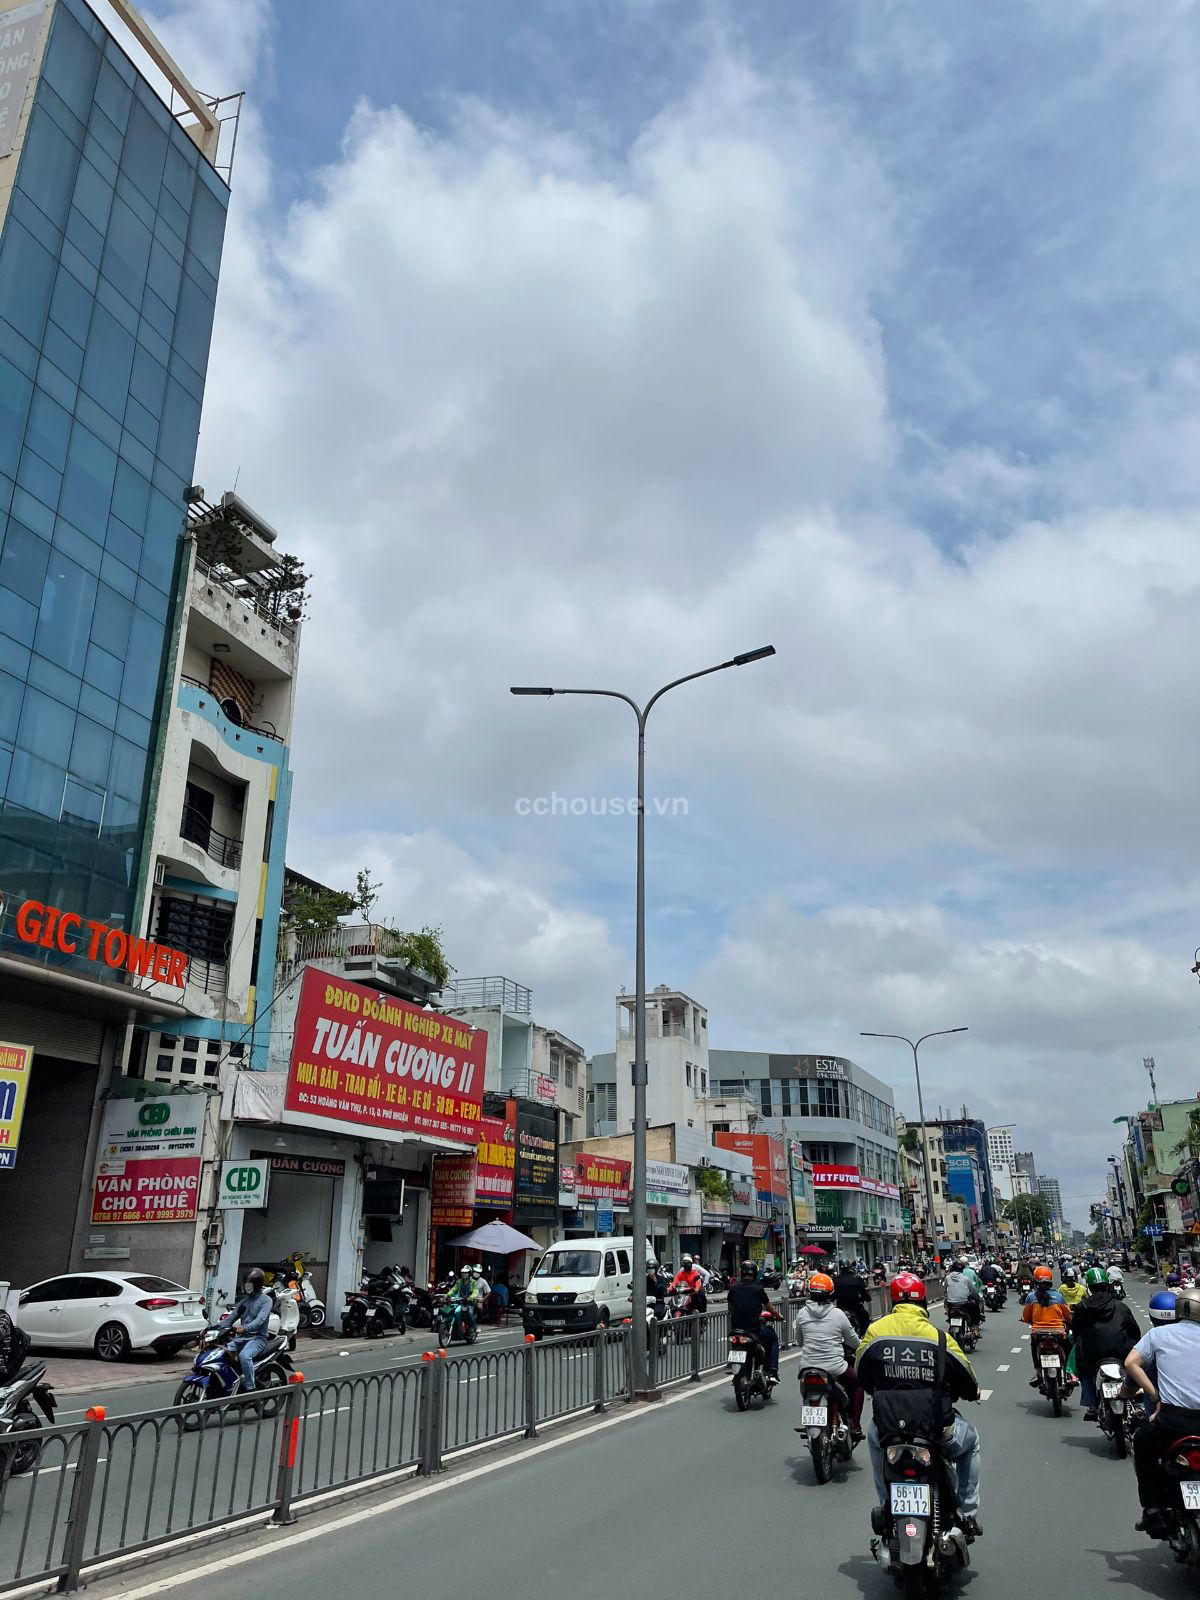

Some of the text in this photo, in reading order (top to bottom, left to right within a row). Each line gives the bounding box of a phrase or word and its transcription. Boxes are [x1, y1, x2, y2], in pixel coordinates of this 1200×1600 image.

[16, 900, 189, 989] GIC TOWER
[324, 984, 360, 1013] ĐĐKD
[404, 1012, 440, 1042] NGHIỆP
[441, 1025, 453, 1044] XE
[312, 1016, 474, 1094] TUẤN CƯƠNG II
[297, 1062, 318, 1086] MUA
[345, 1073, 366, 1096] TRAO
[385, 1083, 397, 1103] XE
[397, 1085, 407, 1105] GA
[411, 1089, 422, 1108] XE
[460, 1101, 480, 1121] VESPA
[309, 1094, 318, 1105] 53
[317, 1096, 338, 1108] HOÀNG
[139, 1103, 171, 1125] CED
[949, 1159, 970, 1167] SCB
[98, 1173, 198, 1192] VĂN PHÒNG
[226, 1167, 261, 1192] CED
[102, 1191, 188, 1210] CHO THUÊ
[112, 1212, 121, 1220] 97
[146, 1211, 154, 1219] 07
[175, 1210, 194, 1218] 3979
[884, 1364, 920, 1379] VOLUNTEER
[897, 1486, 922, 1499] 66-V1
[894, 1500, 927, 1513] 231.12
